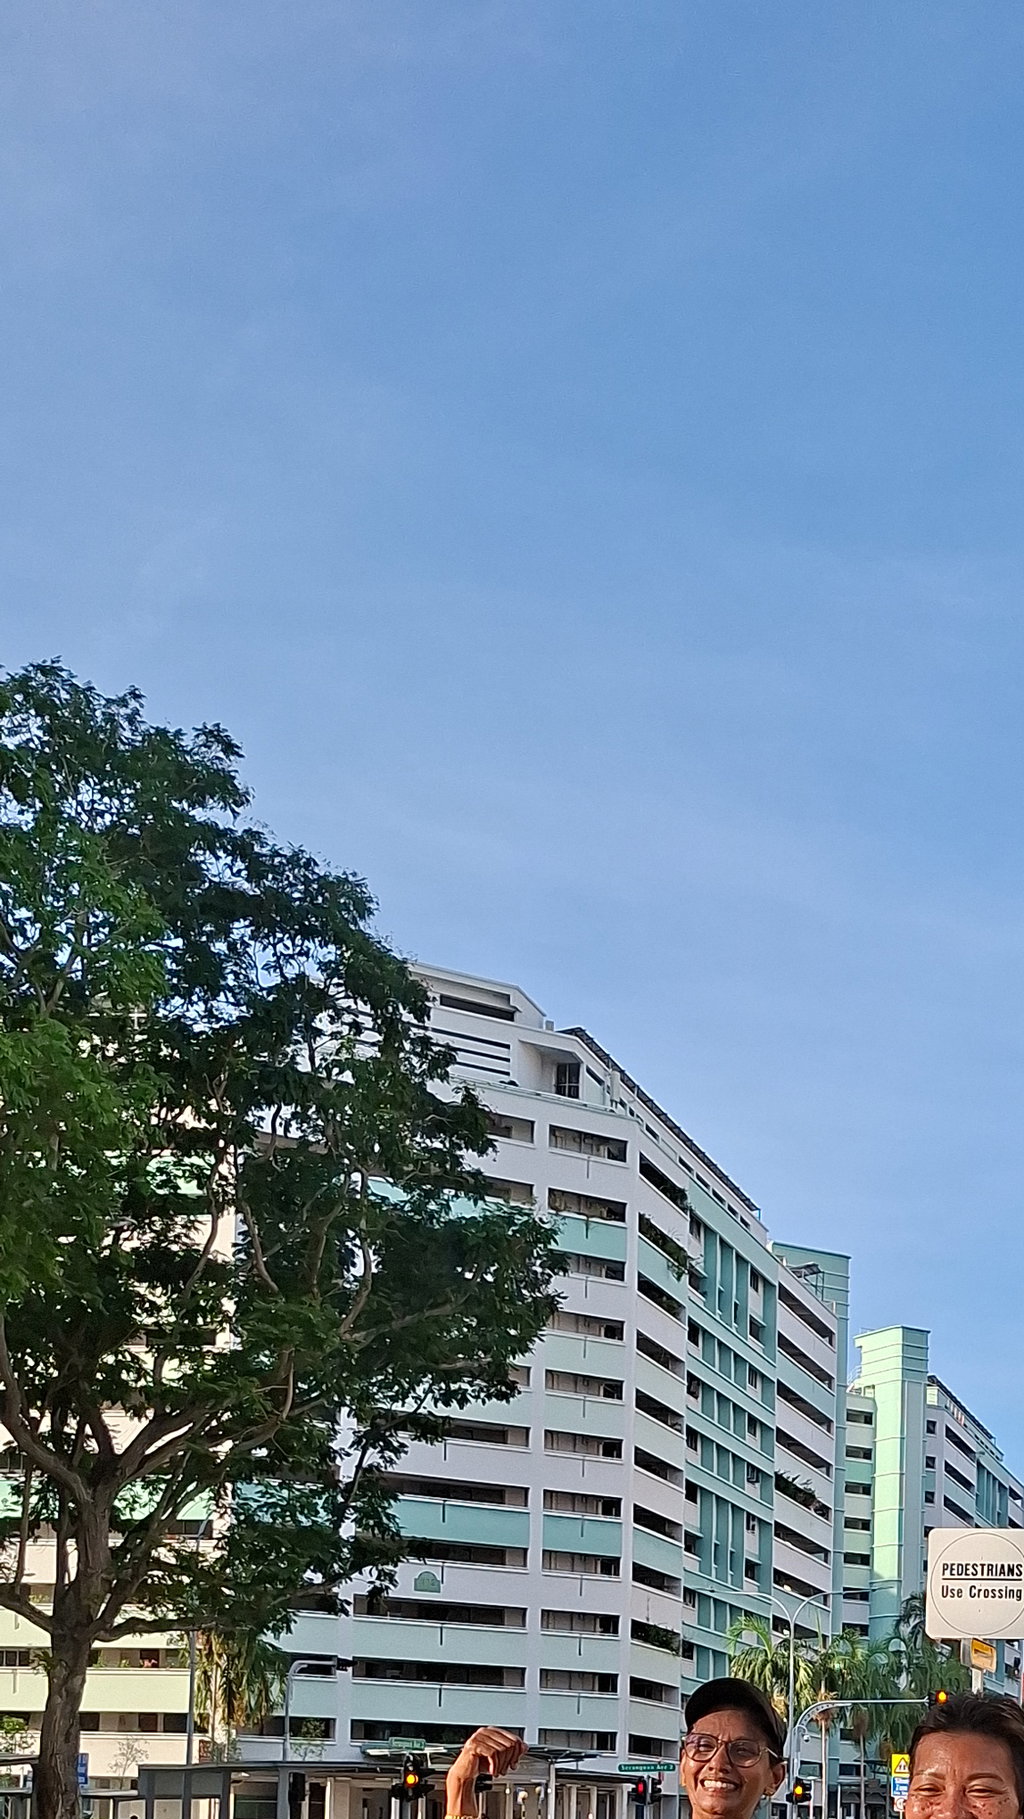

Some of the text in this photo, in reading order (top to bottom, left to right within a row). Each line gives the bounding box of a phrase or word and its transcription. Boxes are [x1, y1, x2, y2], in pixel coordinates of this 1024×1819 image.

[942, 1563, 1023, 1577] PEDESTRIANS
[941, 1585, 1022, 1602] Use Crossing
